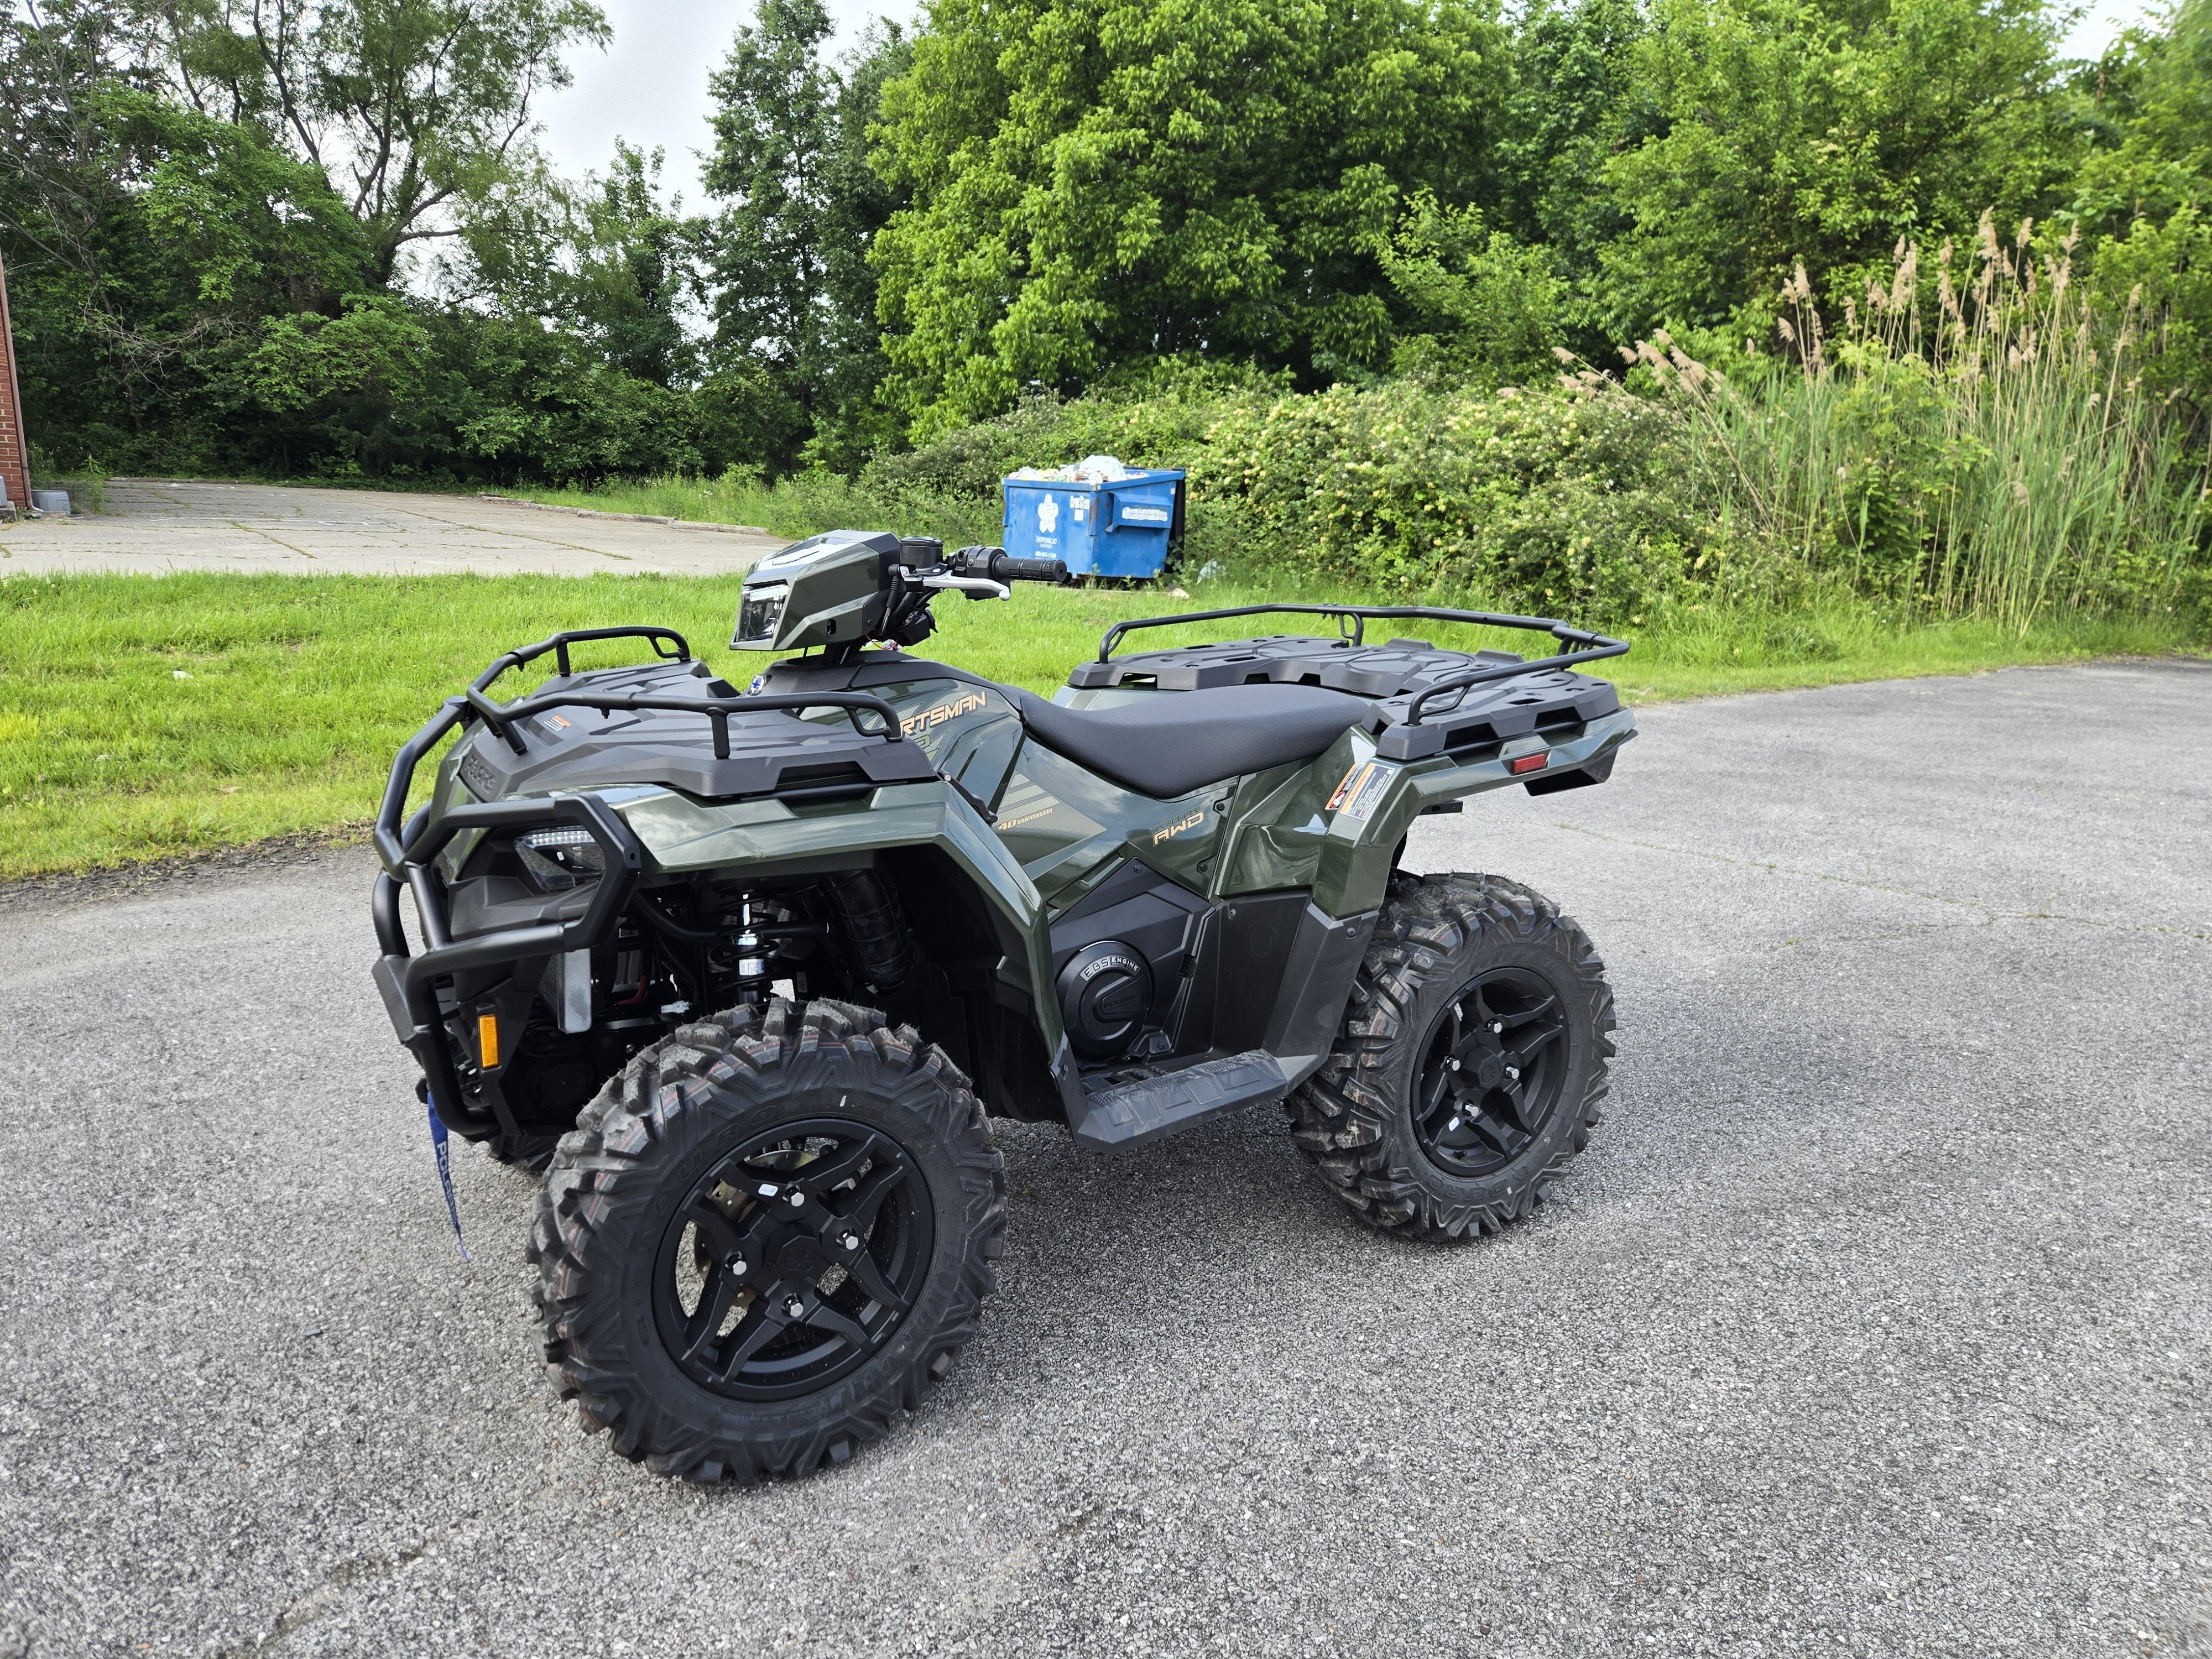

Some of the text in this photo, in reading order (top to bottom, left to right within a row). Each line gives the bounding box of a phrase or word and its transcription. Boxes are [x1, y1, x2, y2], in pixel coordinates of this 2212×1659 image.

[900, 691, 987, 738] RTSMAN
[998, 808, 1053, 830] 40 ANNIVERSARY
[1166, 805, 1203, 827] DEMAND
[1153, 811, 1204, 846] AWD
[1084, 958, 1109, 978] EBS
[1112, 957, 1139, 972] ENGINE
